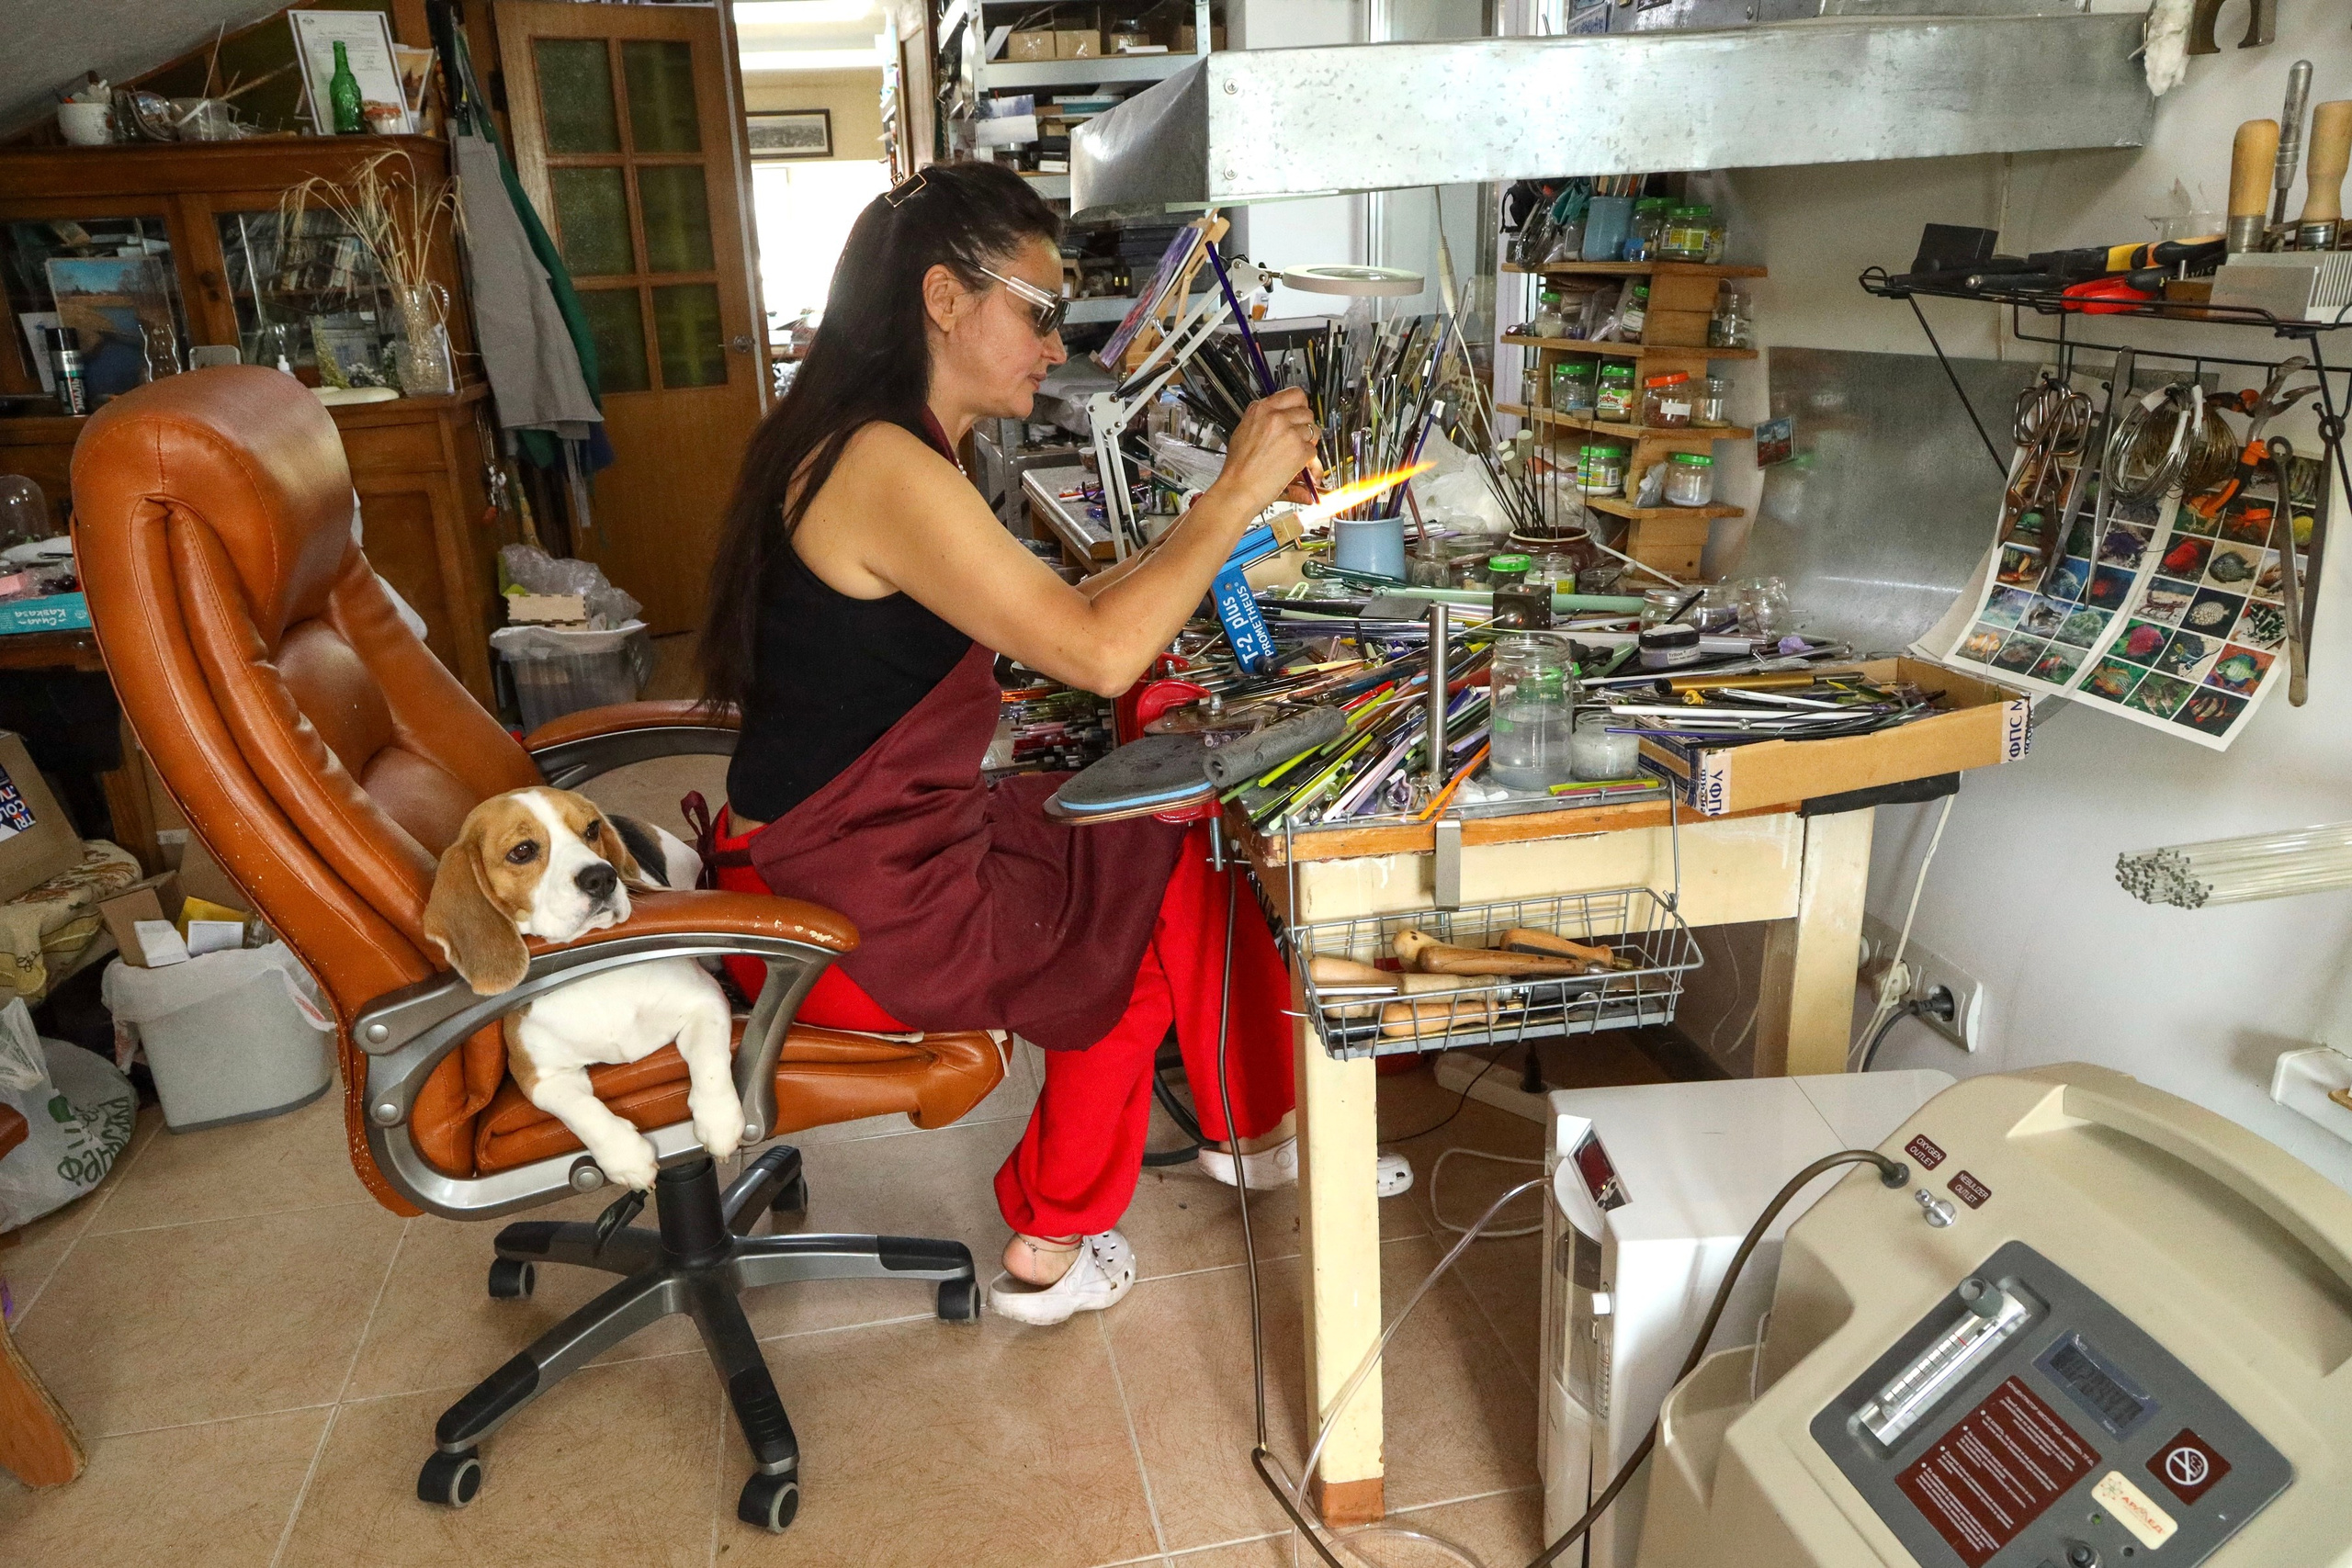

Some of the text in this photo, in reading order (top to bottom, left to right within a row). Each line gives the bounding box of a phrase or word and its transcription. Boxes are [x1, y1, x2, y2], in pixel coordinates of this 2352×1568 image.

[14, 608, 67, 618] Кавказа
[1237, 585, 1274, 657] PROMETHEUS
[1222, 596, 1259, 664] T-2 plus
[2007, 715, 2023, 761] ФПС
[14, 813, 37, 830] TRI
[1909, 1145, 1936, 1167] OUTLET
[1916, 1137, 1943, 1161] OXYGEN
[1954, 1184, 1978, 1203] OUTLET
[1958, 1173, 1989, 1200] NEBULIZER
